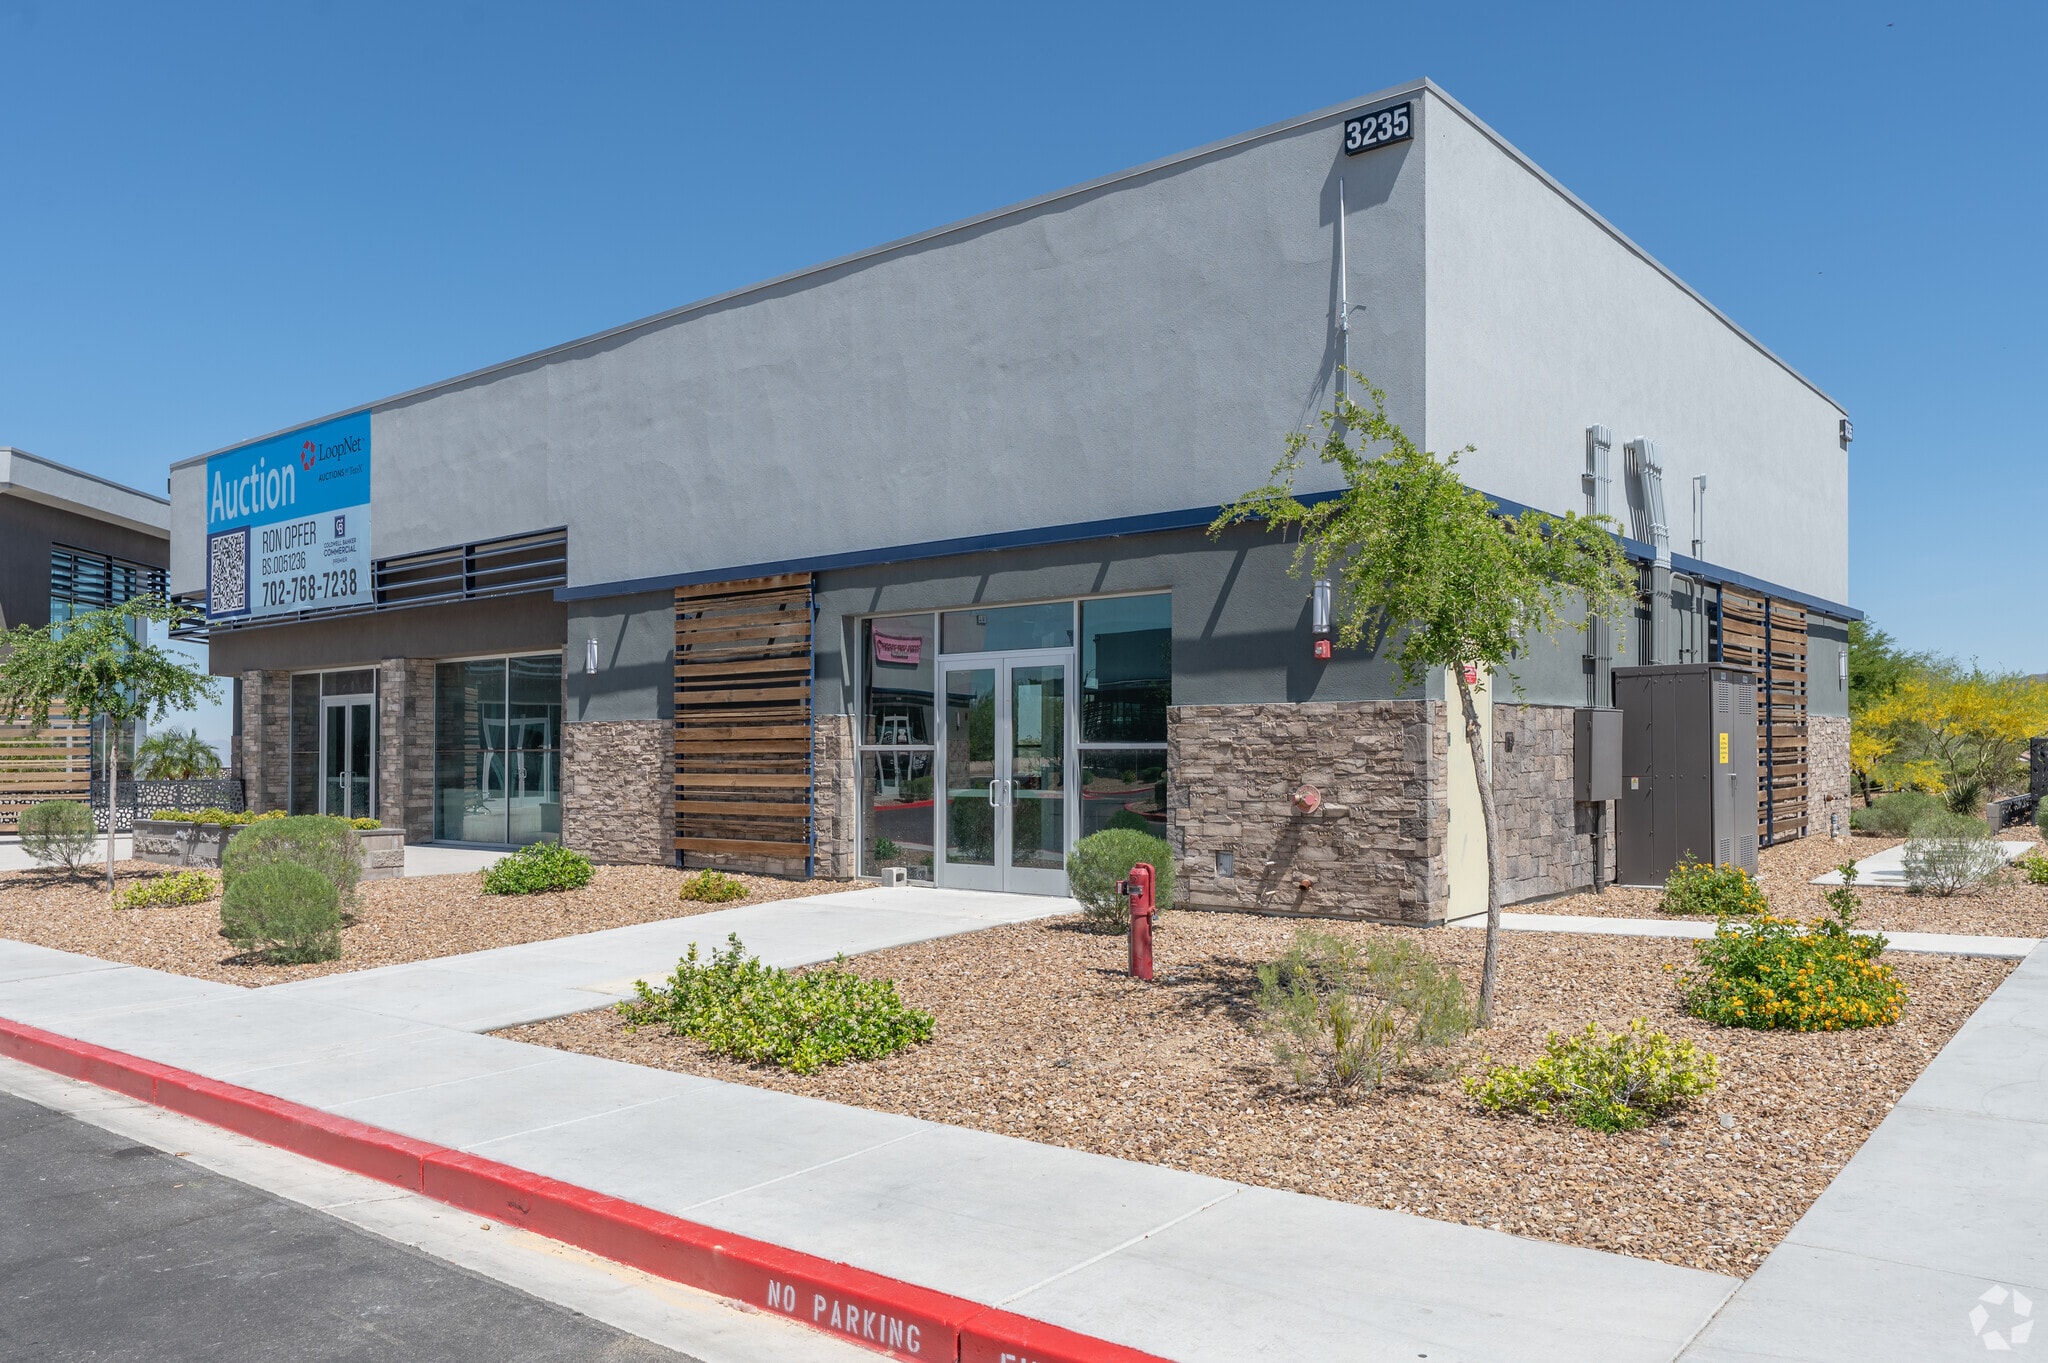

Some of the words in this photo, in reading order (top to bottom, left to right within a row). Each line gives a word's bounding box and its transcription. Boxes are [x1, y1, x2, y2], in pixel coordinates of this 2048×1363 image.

[1346, 106, 1409, 150] 3235
[318, 435, 362, 462] LoopNet
[210, 456, 296, 524] Auction
[318, 468, 345, 482] AUCTIONS
[262, 528, 282, 554] RON
[284, 520, 317, 550] OPFER
[323, 544, 357, 557] COMMERCIAL
[262, 551, 307, 576] BS.0051236
[262, 568, 357, 608] 702-768-7238
[767, 1279, 796, 1313] NO
[813, 1293, 922, 1354] PARKING
